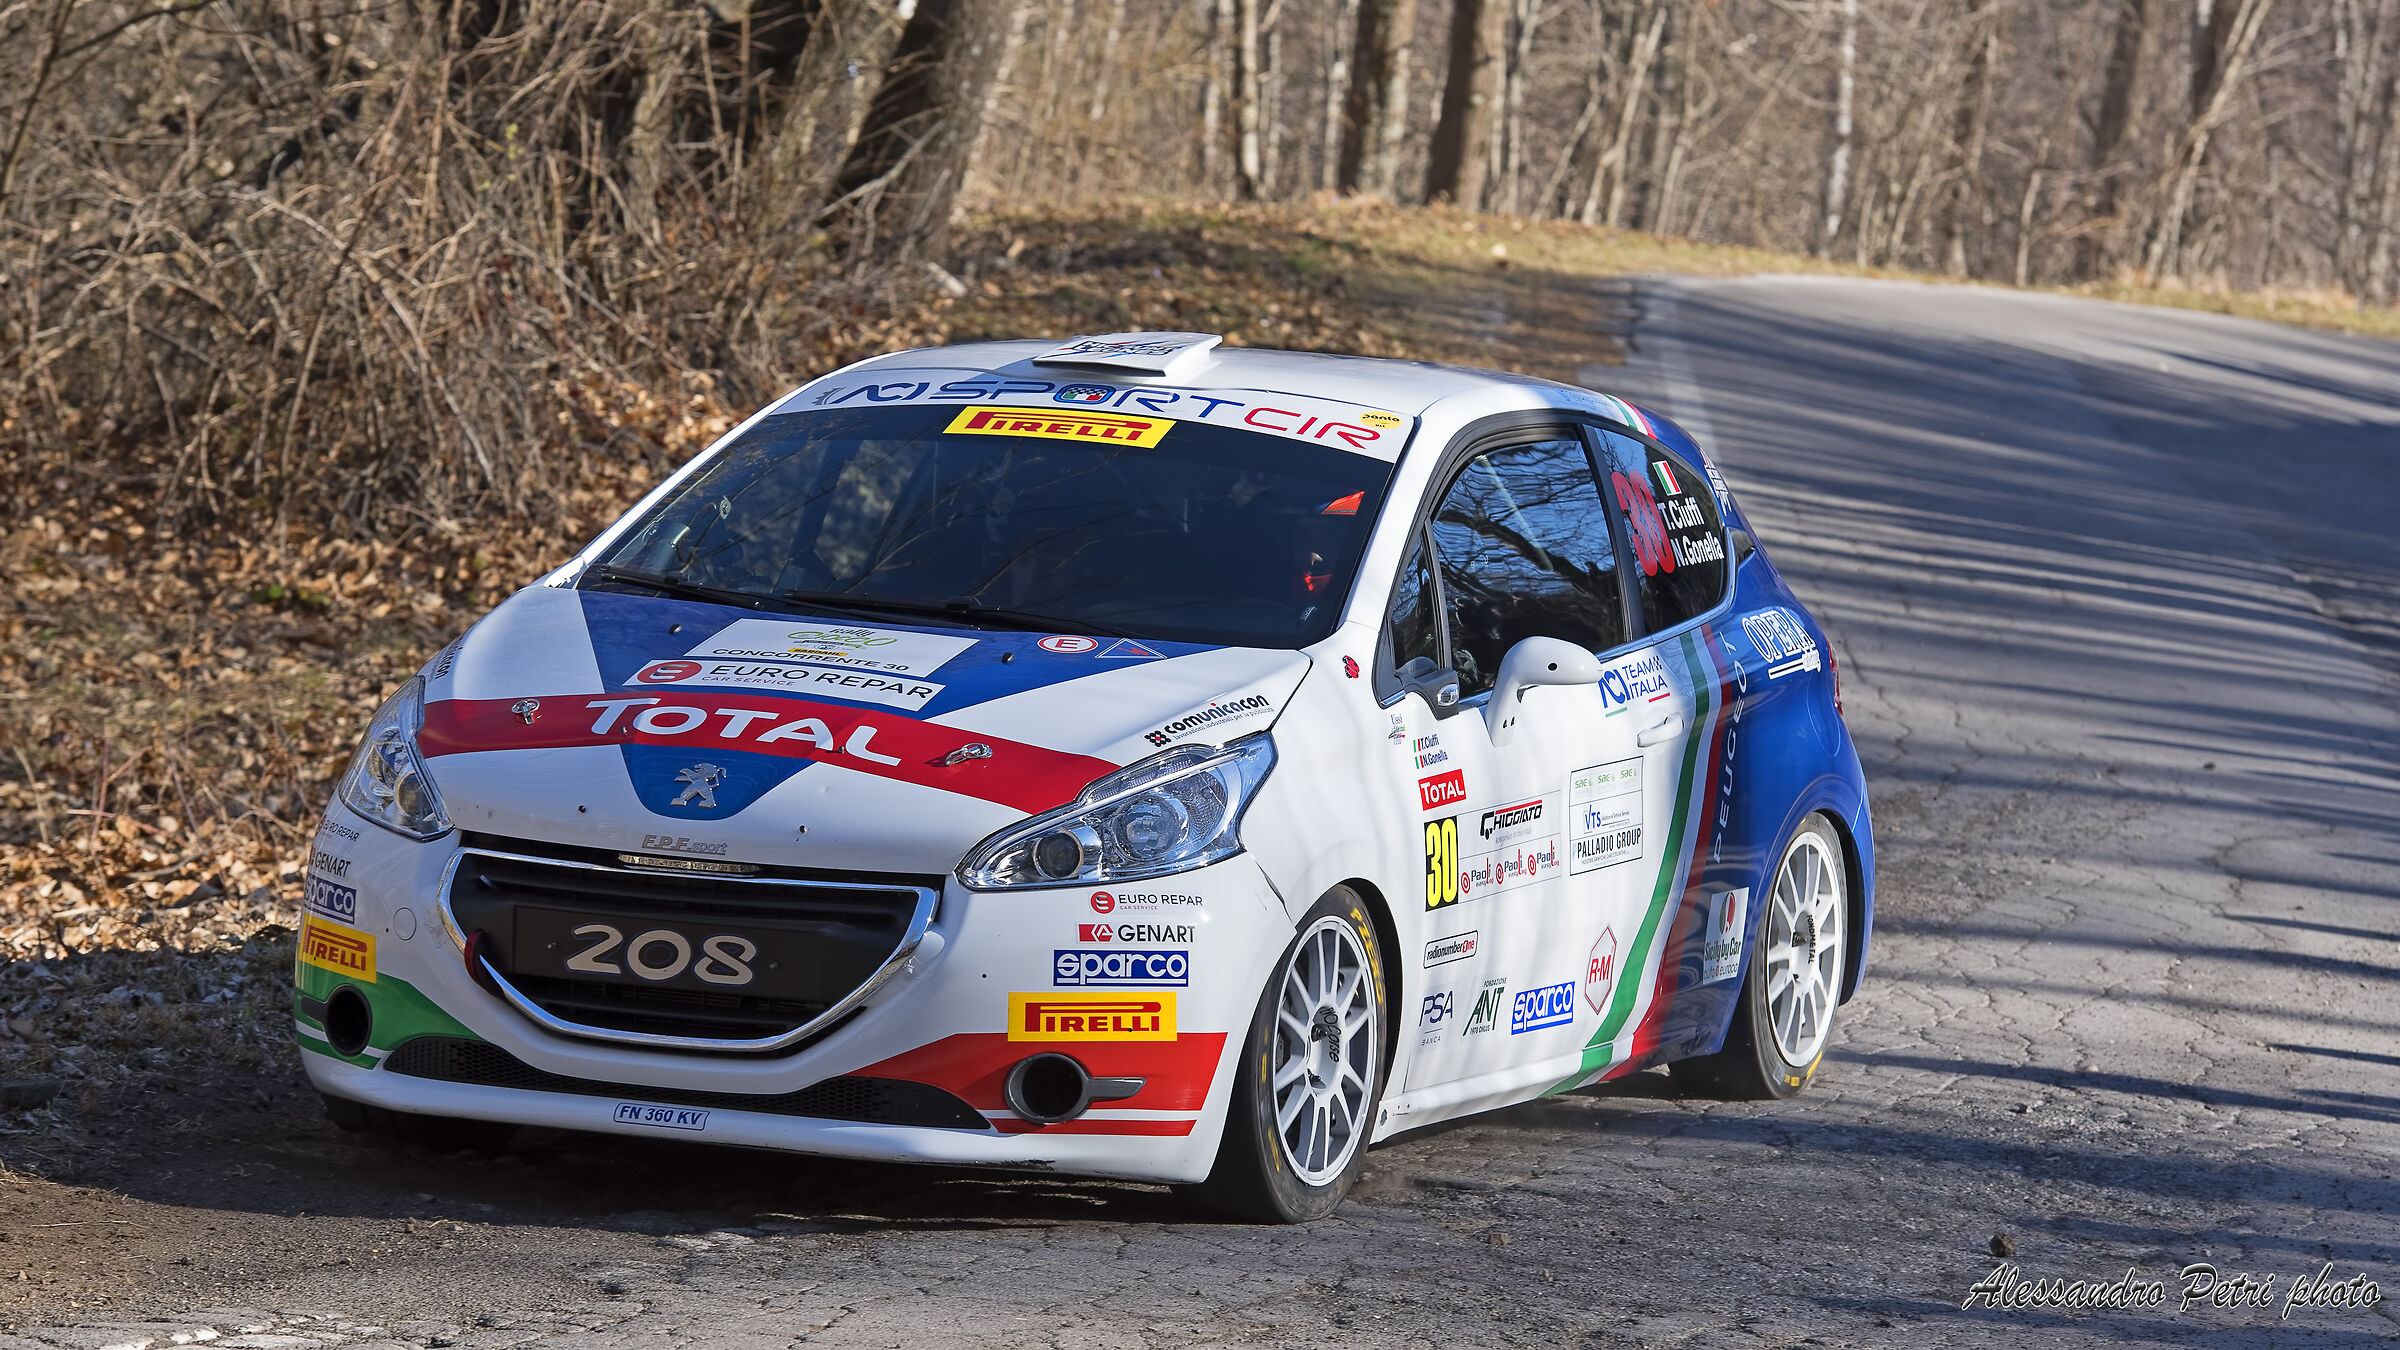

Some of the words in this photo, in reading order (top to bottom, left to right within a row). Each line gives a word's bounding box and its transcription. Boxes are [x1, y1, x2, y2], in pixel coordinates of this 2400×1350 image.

[964, 410, 1153, 441] PIRELLI
[1243, 407, 1381, 450] CIR
[1610, 469, 1676, 577] 30
[1656, 496, 1705, 531] T.Ciuffi
[1670, 530, 1725, 568] N.Gonella
[712, 648, 881, 668] CONCORRENTE
[883, 663, 910, 672] 30
[1621, 657, 1656, 681] TEAM
[701, 676, 728, 685] CAR
[731, 677, 796, 687] SERVICE
[709, 664, 810, 680] EURO
[814, 672, 934, 699] REPAR
[1629, 674, 1668, 700] ITALIA
[1163, 694, 1270, 734] comunicacon
[585, 697, 902, 767] TOTAL
[1420, 733, 1440, 750] T.Ciuffi
[1712, 631, 1748, 865] PEUGEOT
[1422, 749, 1449, 767] N.Gonella
[1420, 779, 1465, 805] TOTAL
[1584, 804, 1602, 830] VTS
[1577, 834, 1614, 859] PALLADIO
[1616, 827, 1642, 850] GROUP
[314, 850, 352, 878] GENART
[1425, 818, 1458, 907] 30
[1118, 893, 1158, 905] EURO
[1161, 893, 1203, 907] REPAR
[302, 922, 368, 972] PIRELLI
[1117, 924, 1196, 943] GENART
[1805, 914, 1817, 965] FONDMETAL
[566, 924, 757, 985] 208
[1056, 953, 1188, 986] sparco
[1024, 1001, 1162, 1033] PIRELLI
[1418, 990, 1453, 1027] PSA
[1462, 986, 1505, 1037] ANT
[1513, 983, 1573, 1031] sparco
[619, 1104, 643, 1120] FN
[644, 1107, 674, 1123] 360
[676, 1110, 704, 1126] KV
